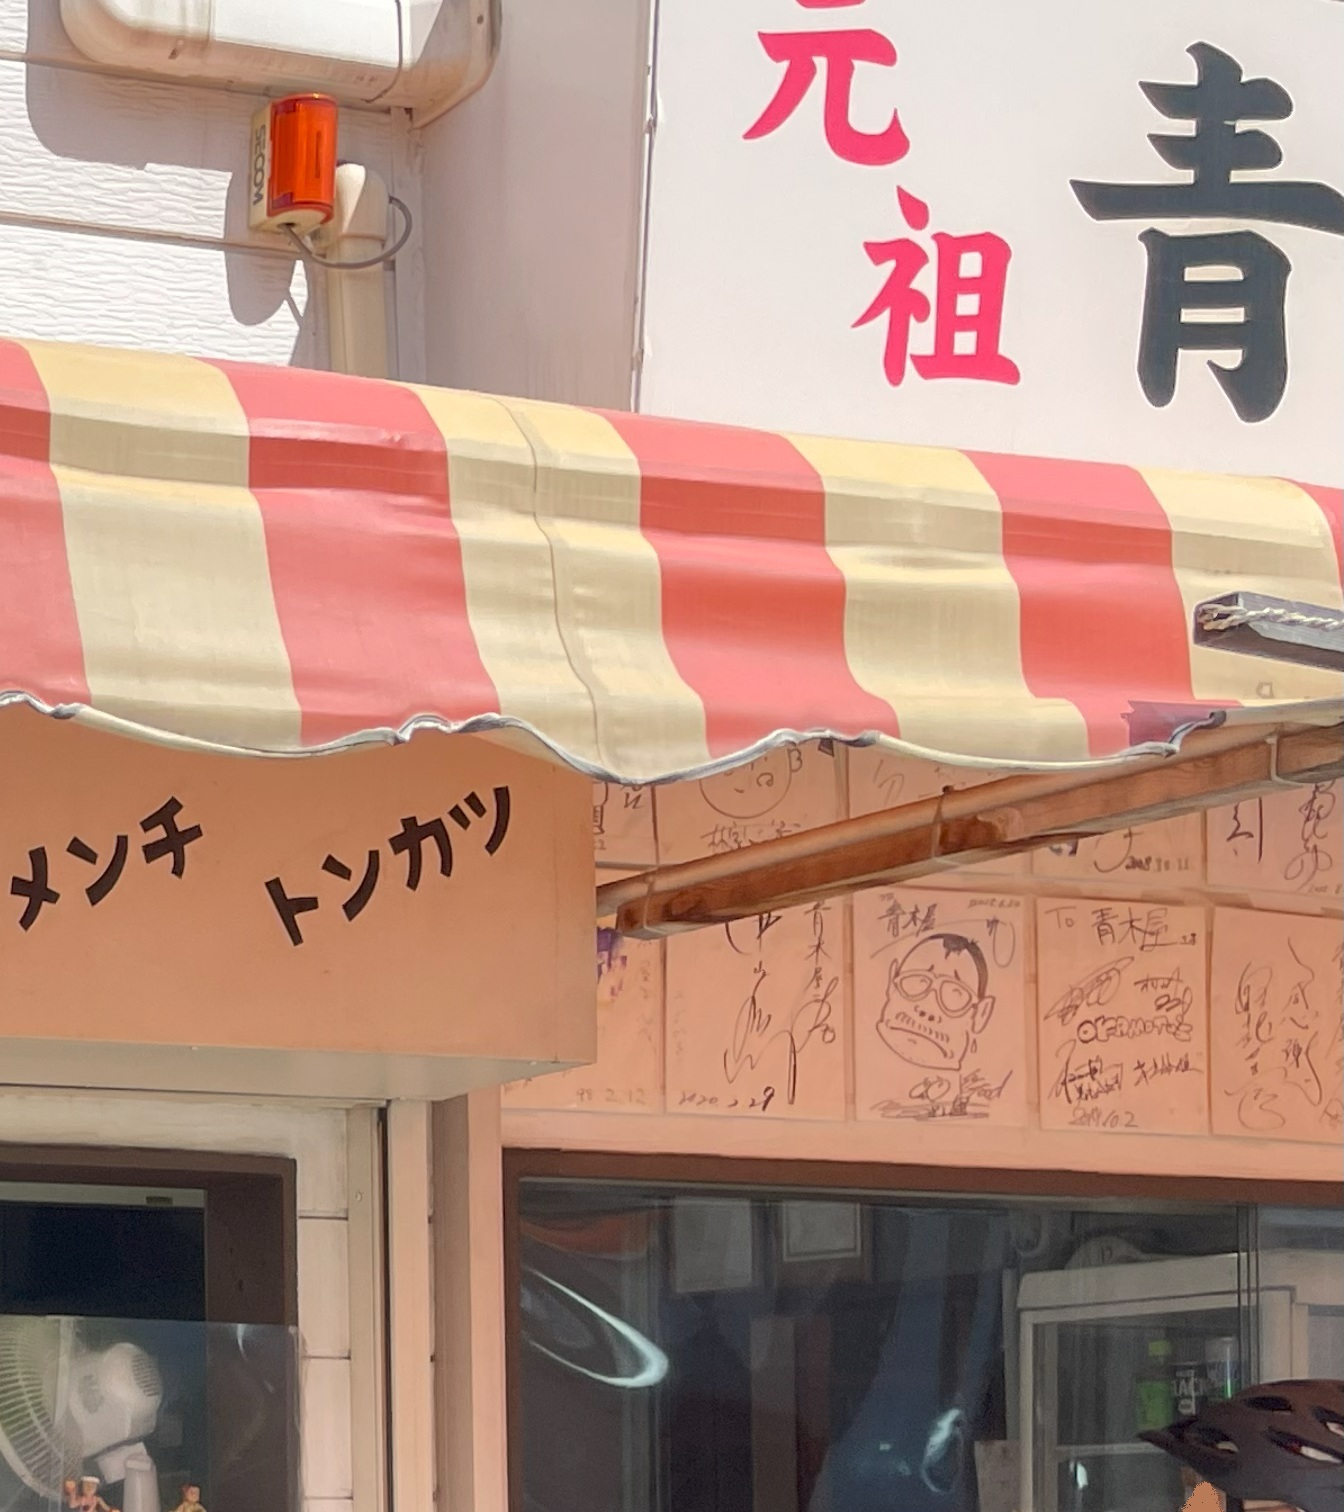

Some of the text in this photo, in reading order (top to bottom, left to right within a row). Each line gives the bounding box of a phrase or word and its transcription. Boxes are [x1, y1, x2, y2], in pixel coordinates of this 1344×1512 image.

[252, 123, 266, 206] SECOM
[742, 0, 1021, 387] 元祖
[1068, 41, 1344, 424] 青
[11, 796, 203, 932] メンチ
[264, 785, 511, 947] トンカツ
